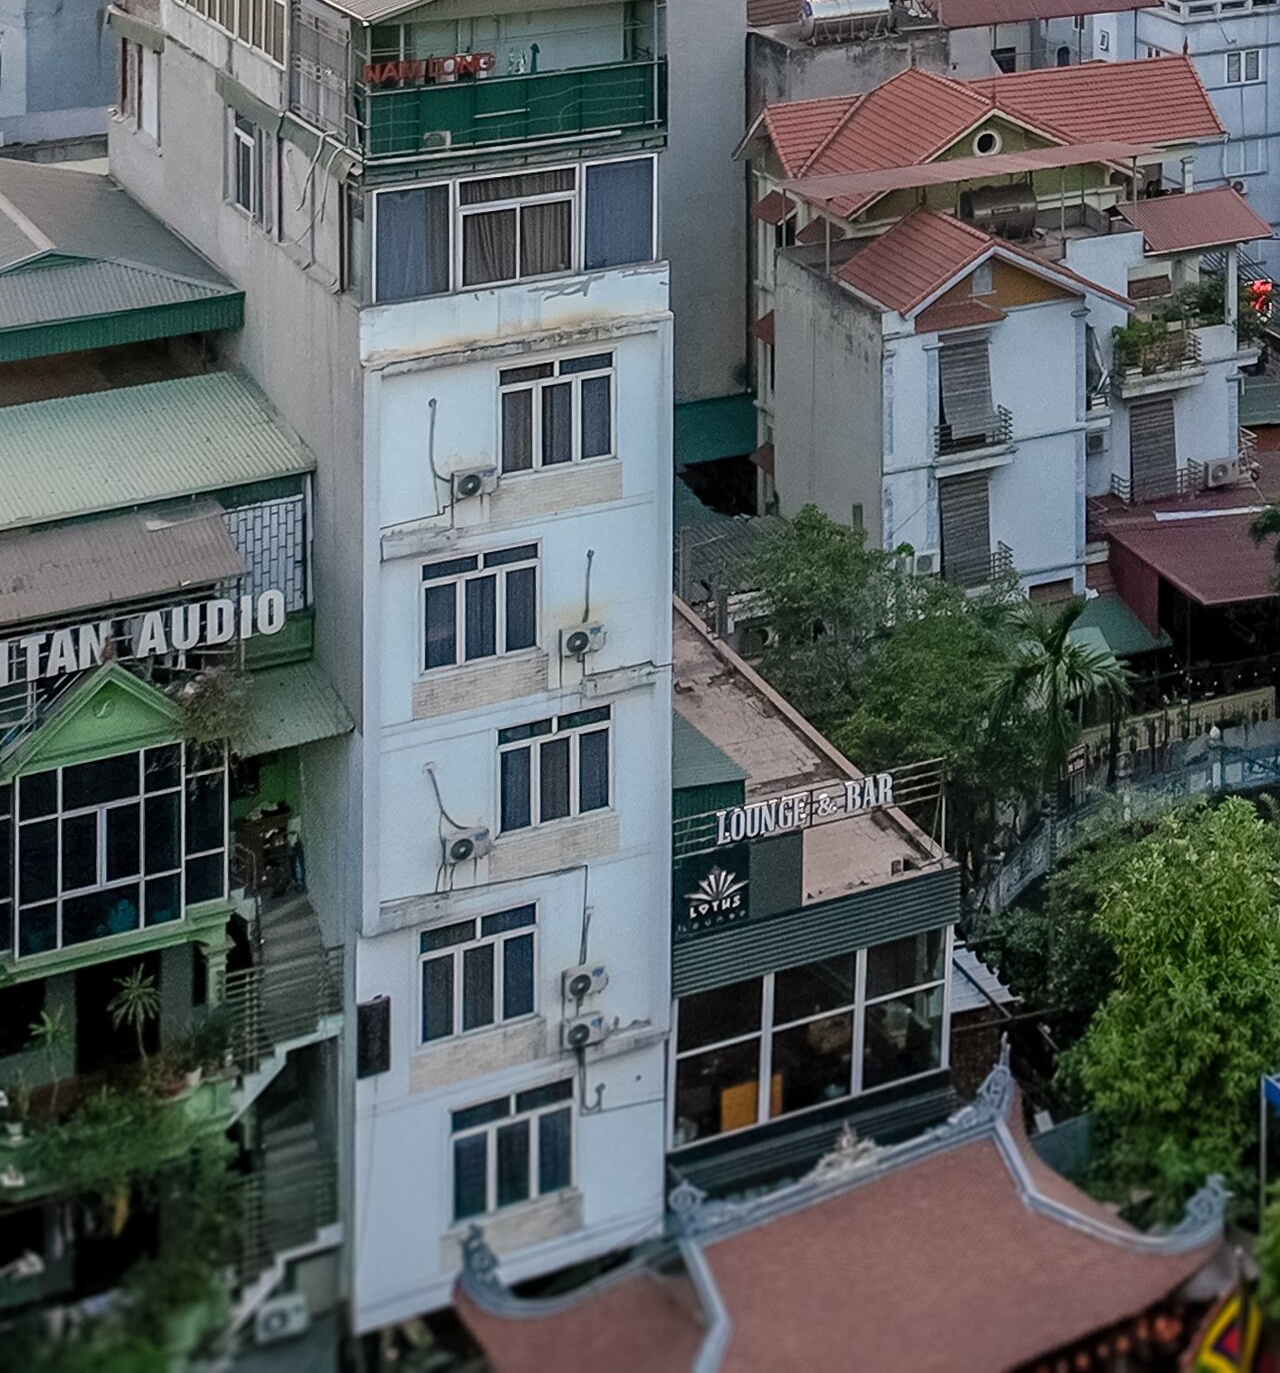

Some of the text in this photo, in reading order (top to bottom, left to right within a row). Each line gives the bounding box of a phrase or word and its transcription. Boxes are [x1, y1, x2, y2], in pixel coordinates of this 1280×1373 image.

[136, 588, 285, 658] AUDIO
[716, 772, 894, 845] LOUNGE & BAR
[689, 894, 742, 919] LOTUS
